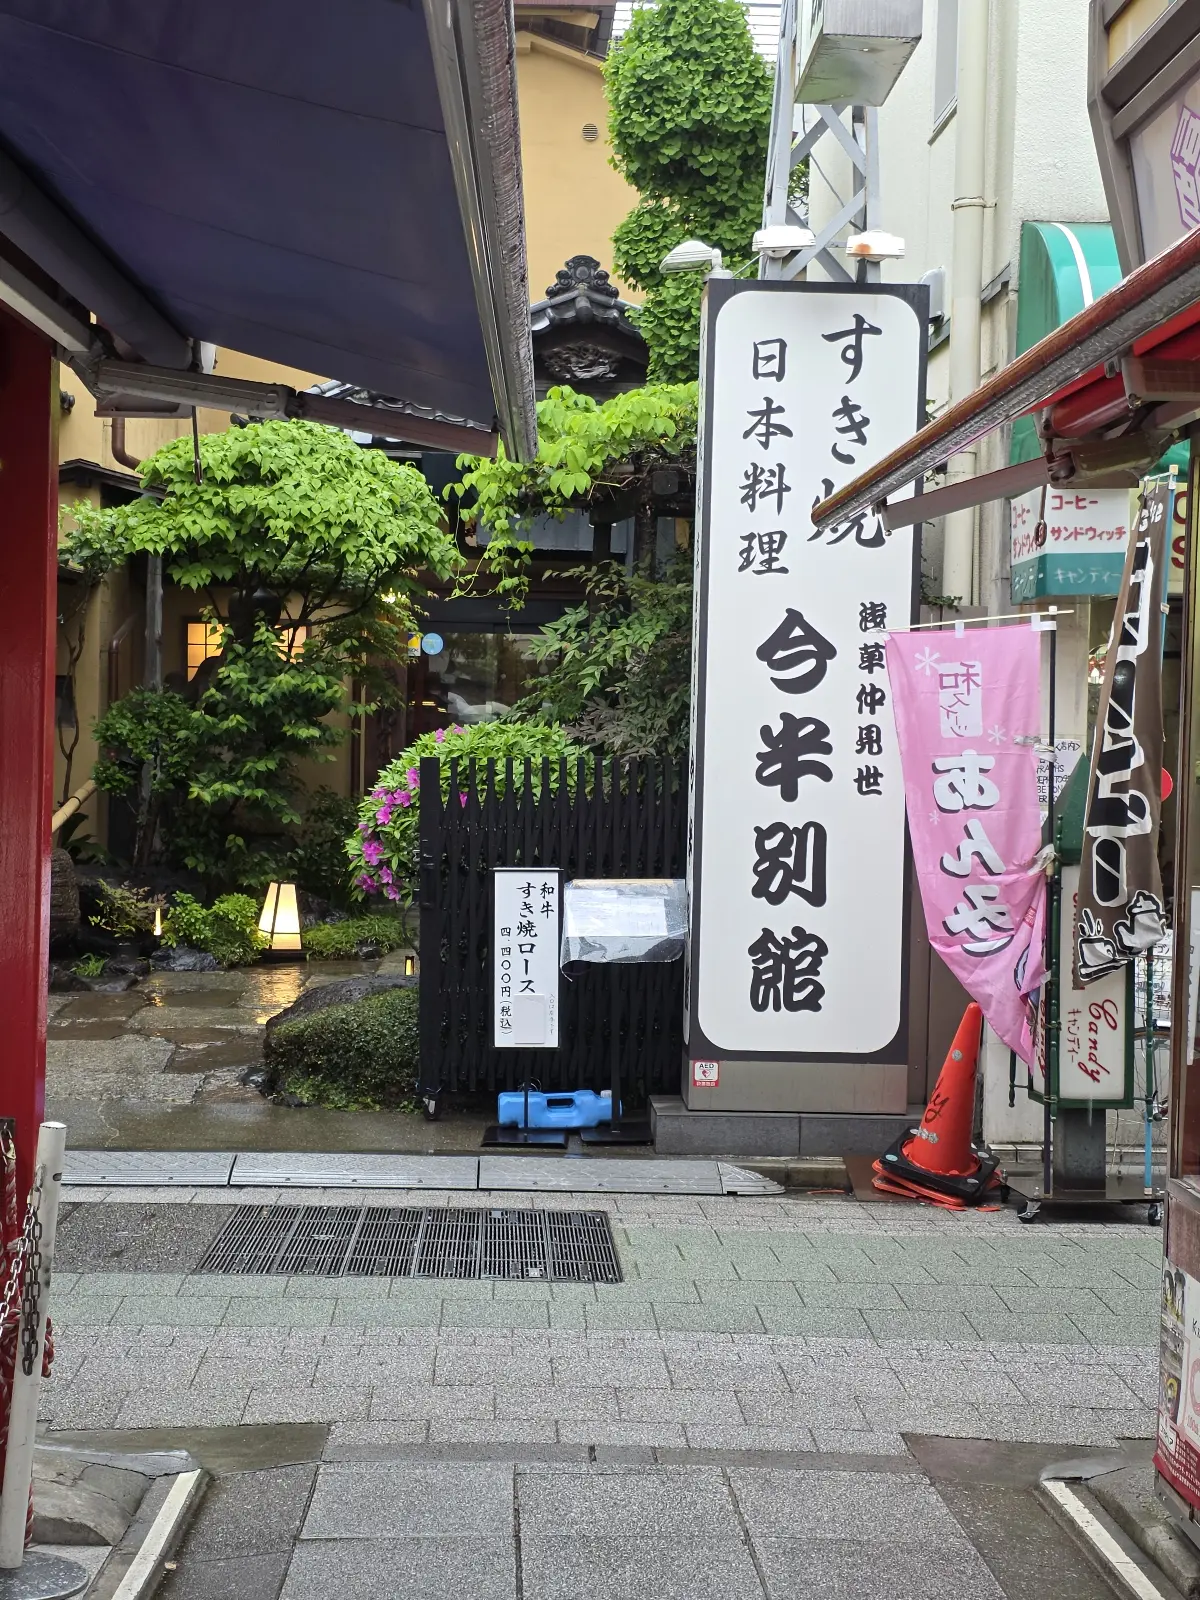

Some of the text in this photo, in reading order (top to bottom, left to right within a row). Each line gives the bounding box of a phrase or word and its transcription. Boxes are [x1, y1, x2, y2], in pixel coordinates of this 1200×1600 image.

[738, 338, 793, 576] 日本料理
[1012, 504, 1031, 529] コーヒー
[1051, 495, 1099, 510] コーヒー
[1050, 526, 1126, 541] サンドウィッチ
[1054, 569, 1122, 584] キャンディー
[852, 601, 887, 797] 浅草仲見世
[747, 607, 838, 1014] 今半別館
[540, 881, 555, 919] 和牛
[516, 881, 538, 994] すき焼ロース
[1067, 1008, 1082, 1063] キャンディー
[1078, 999, 1118, 1083] Candy
